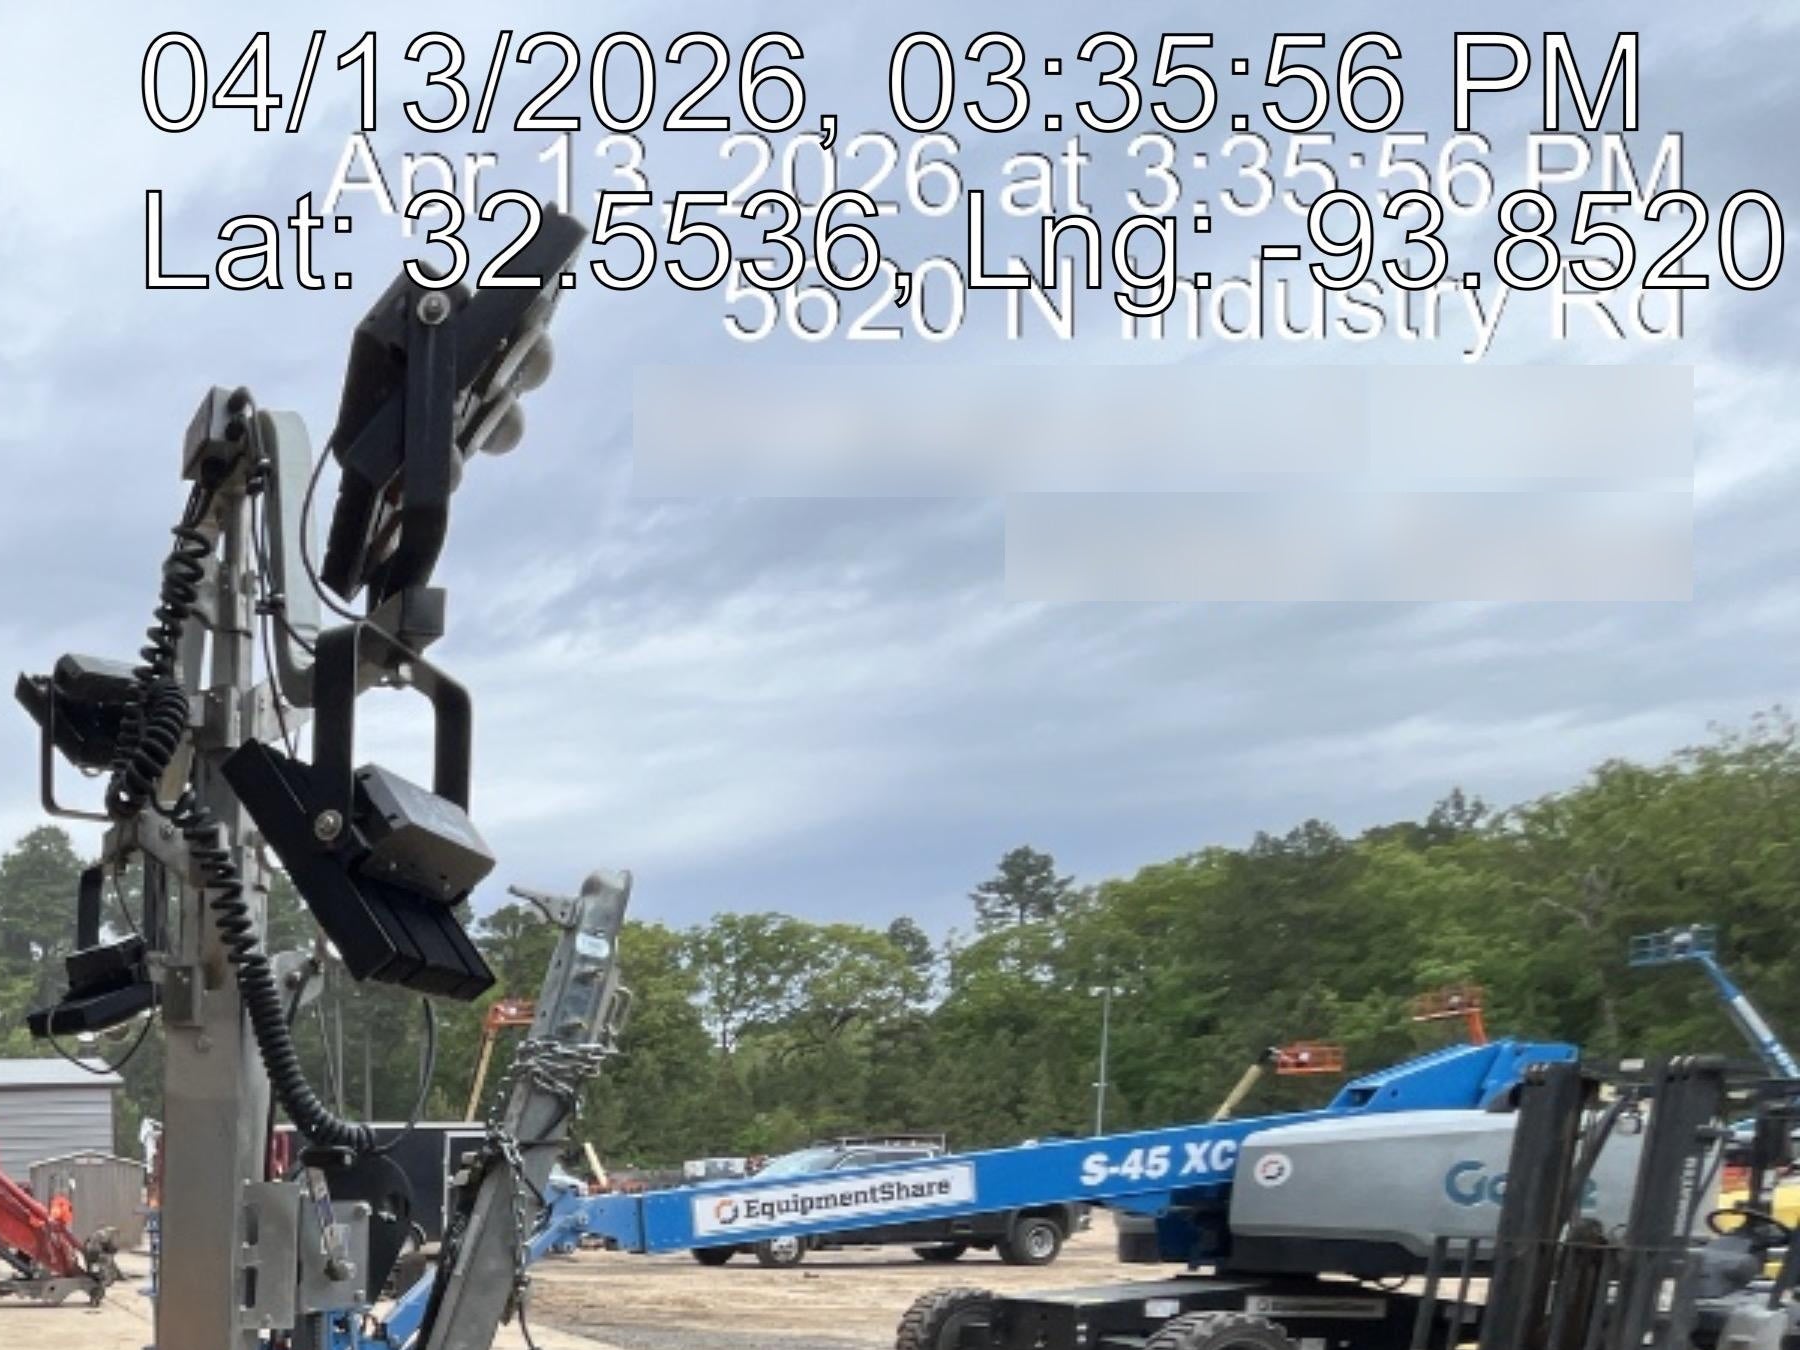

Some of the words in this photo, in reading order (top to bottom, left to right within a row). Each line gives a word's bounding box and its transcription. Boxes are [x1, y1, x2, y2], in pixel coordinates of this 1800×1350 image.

[1079, 1145, 1171, 1186] S-45
[1179, 1139, 1236, 1176] XC
[743, 1177, 951, 1220] EquipmentShare
